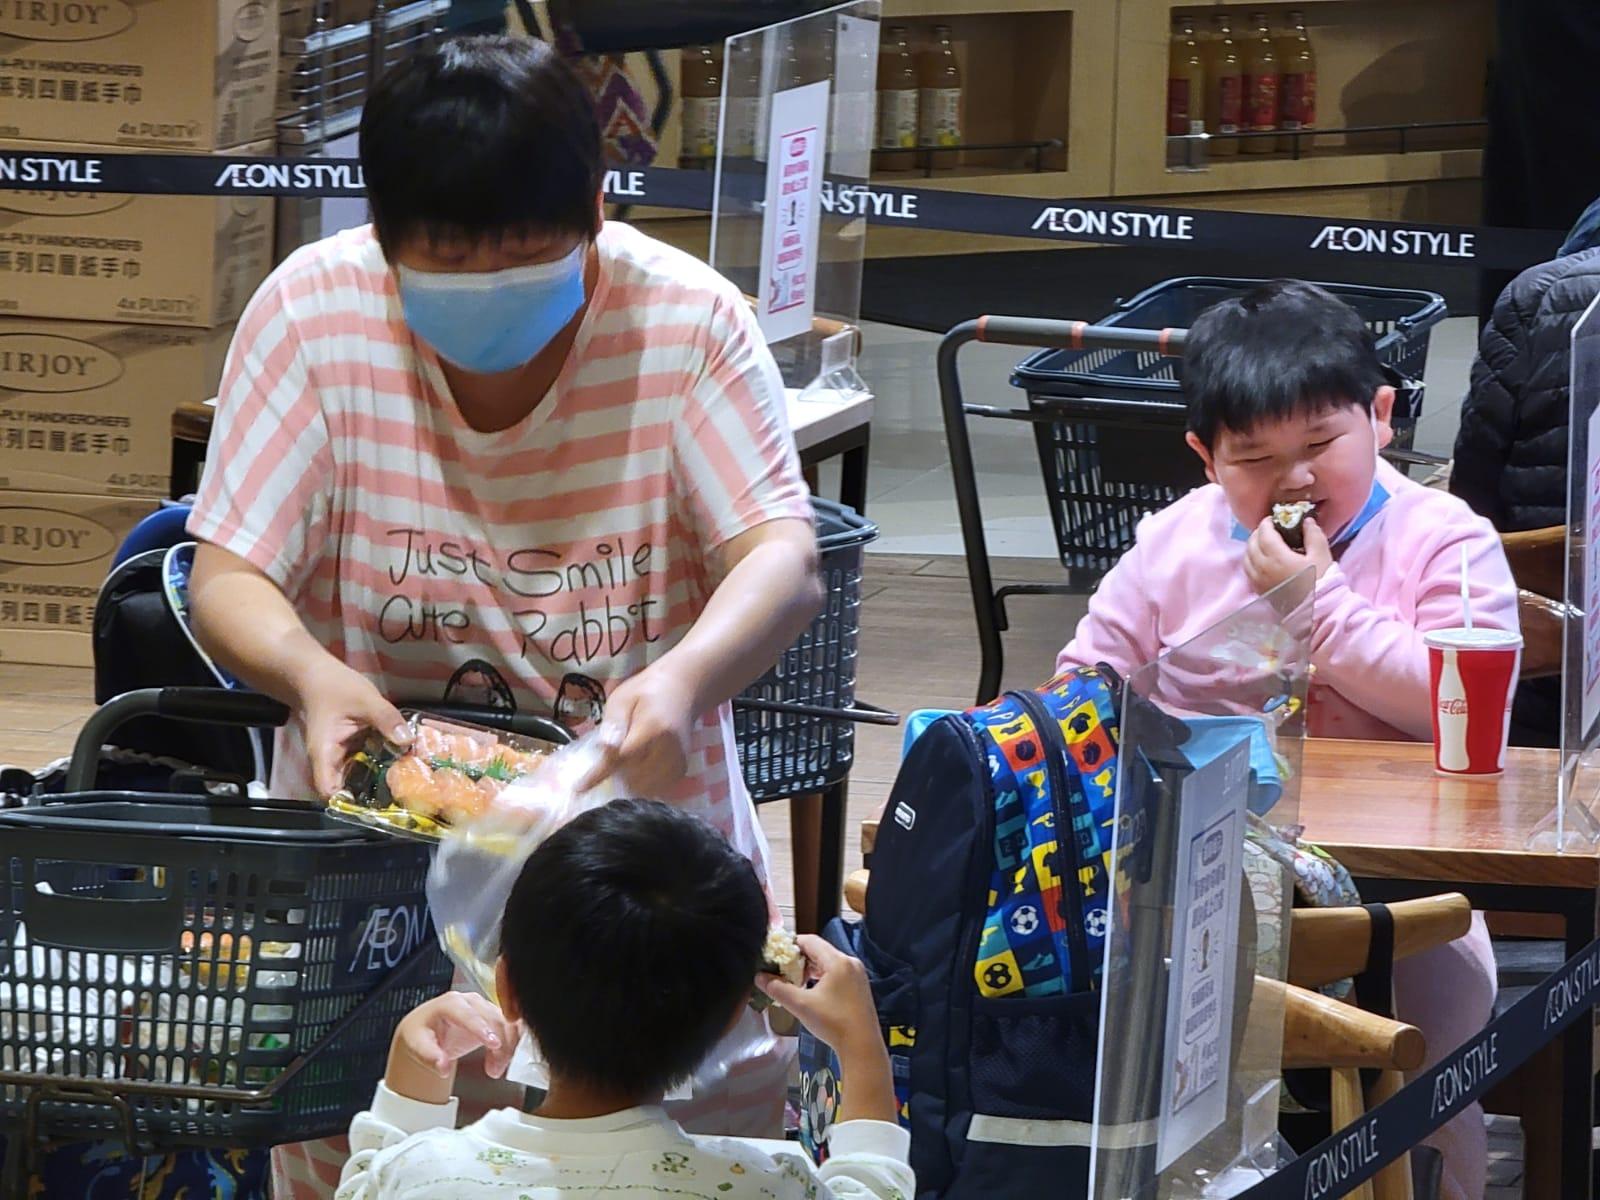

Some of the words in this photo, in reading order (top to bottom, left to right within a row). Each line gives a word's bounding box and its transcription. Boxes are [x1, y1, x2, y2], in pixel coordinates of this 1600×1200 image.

[0, 1, 101, 26] IRJOY
[20, 158, 103, 183] STYLE
[838, 189, 919, 219] STYLE
[1110, 212, 1194, 240] STYLE
[1391, 230, 1476, 258] STYLE
[387, 528, 497, 587] Just
[502, 537, 652, 598] Smile
[512, 594, 660, 666] Rabbt
[1574, 951, 1600, 1003] STYL
[1464, 1032, 1498, 1091] STYLE
[1340, 1118, 1379, 1179] STYLE
